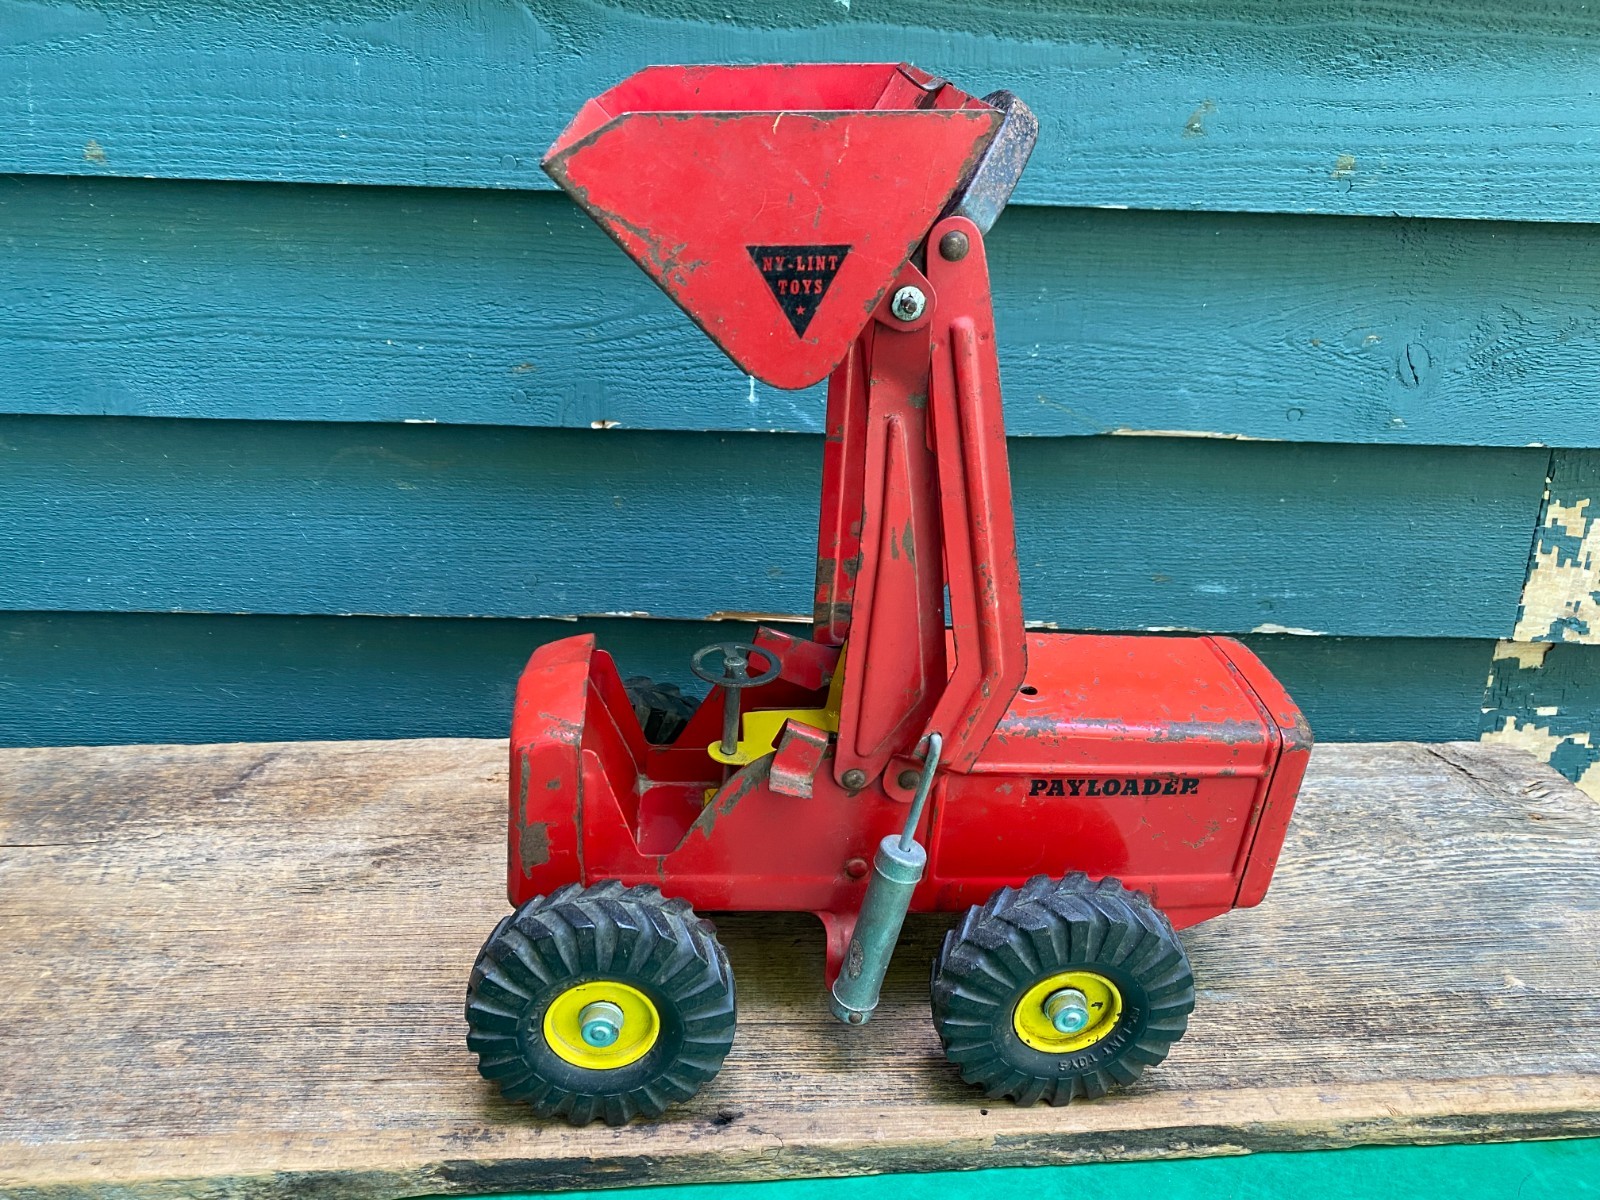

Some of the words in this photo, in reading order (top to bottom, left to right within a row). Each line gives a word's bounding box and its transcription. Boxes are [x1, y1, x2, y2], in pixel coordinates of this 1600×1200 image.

[762, 255, 838, 271] NY-LINT
[778, 279, 823, 295] TOYS
[1028, 778, 1200, 796] PAYLOADER
